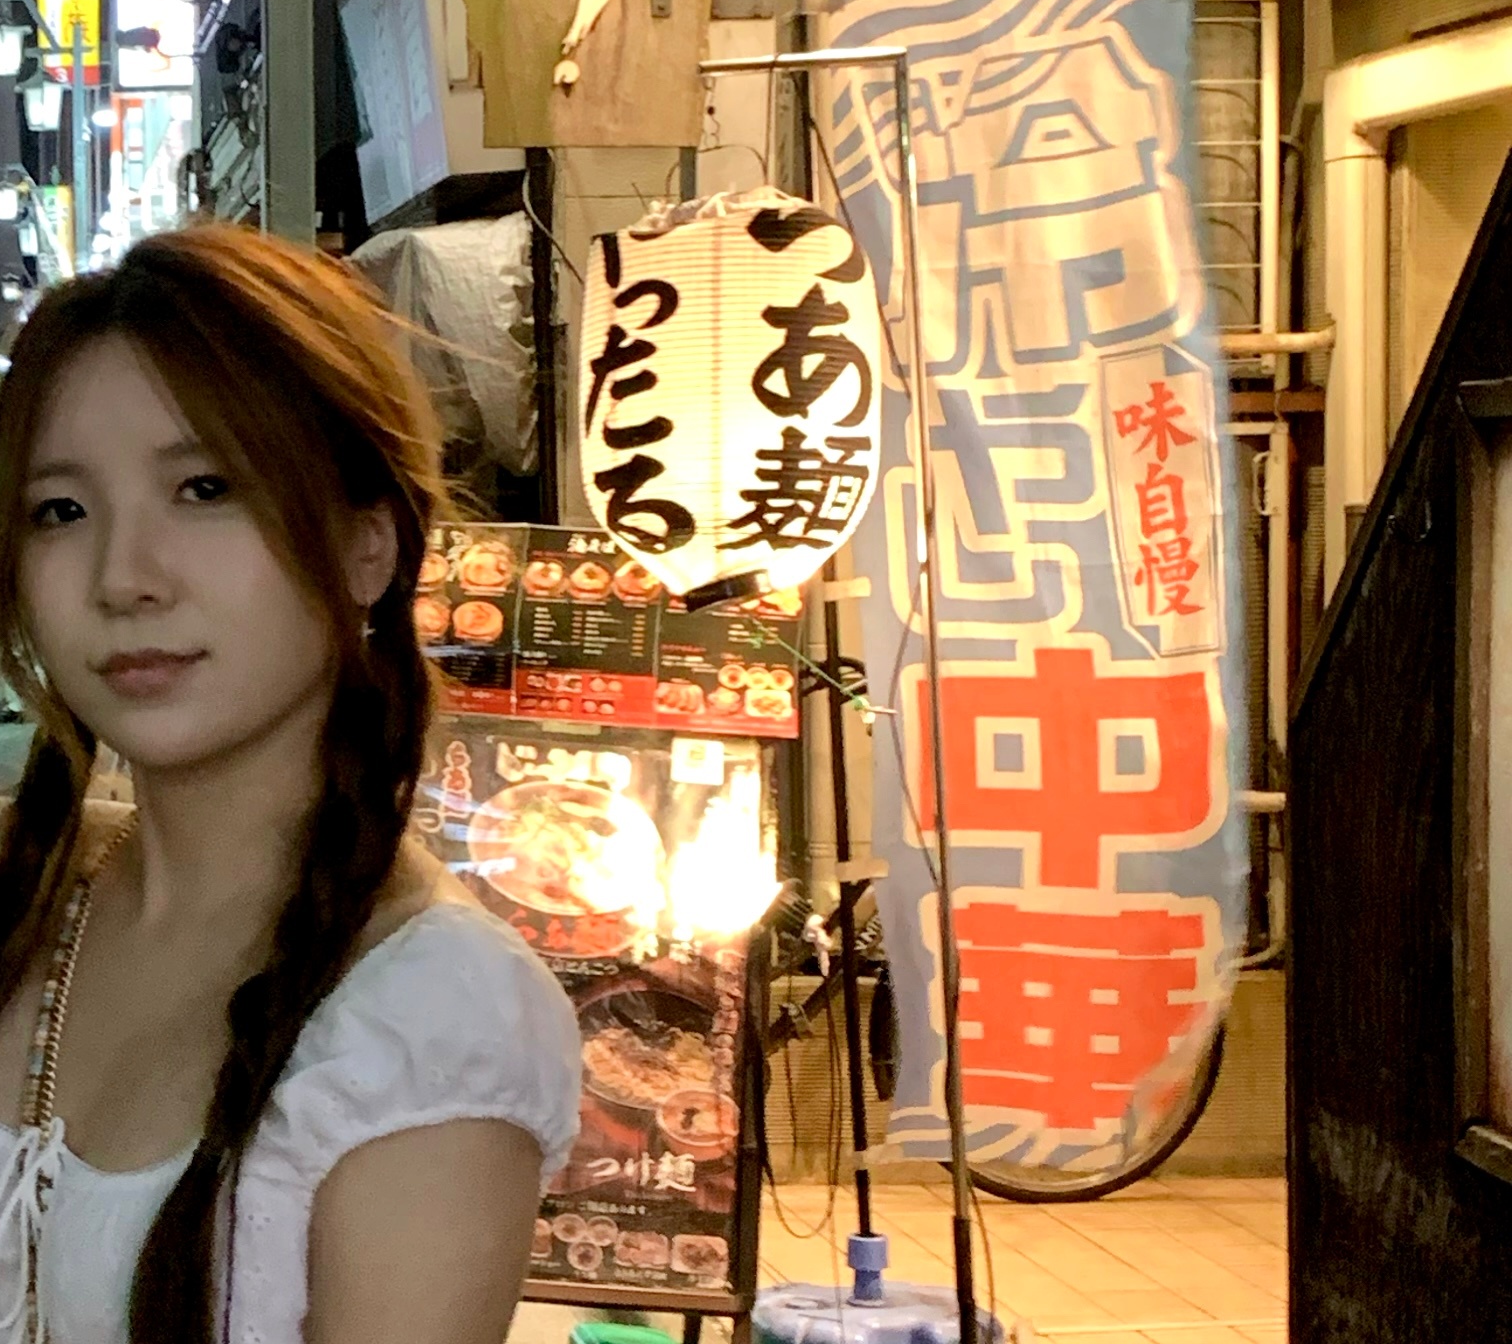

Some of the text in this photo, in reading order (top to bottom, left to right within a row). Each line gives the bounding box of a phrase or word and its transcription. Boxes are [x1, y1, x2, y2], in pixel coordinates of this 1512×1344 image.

[1112, 380, 1210, 618] 味自慢
[585, 1150, 697, 1192] つけ麺
